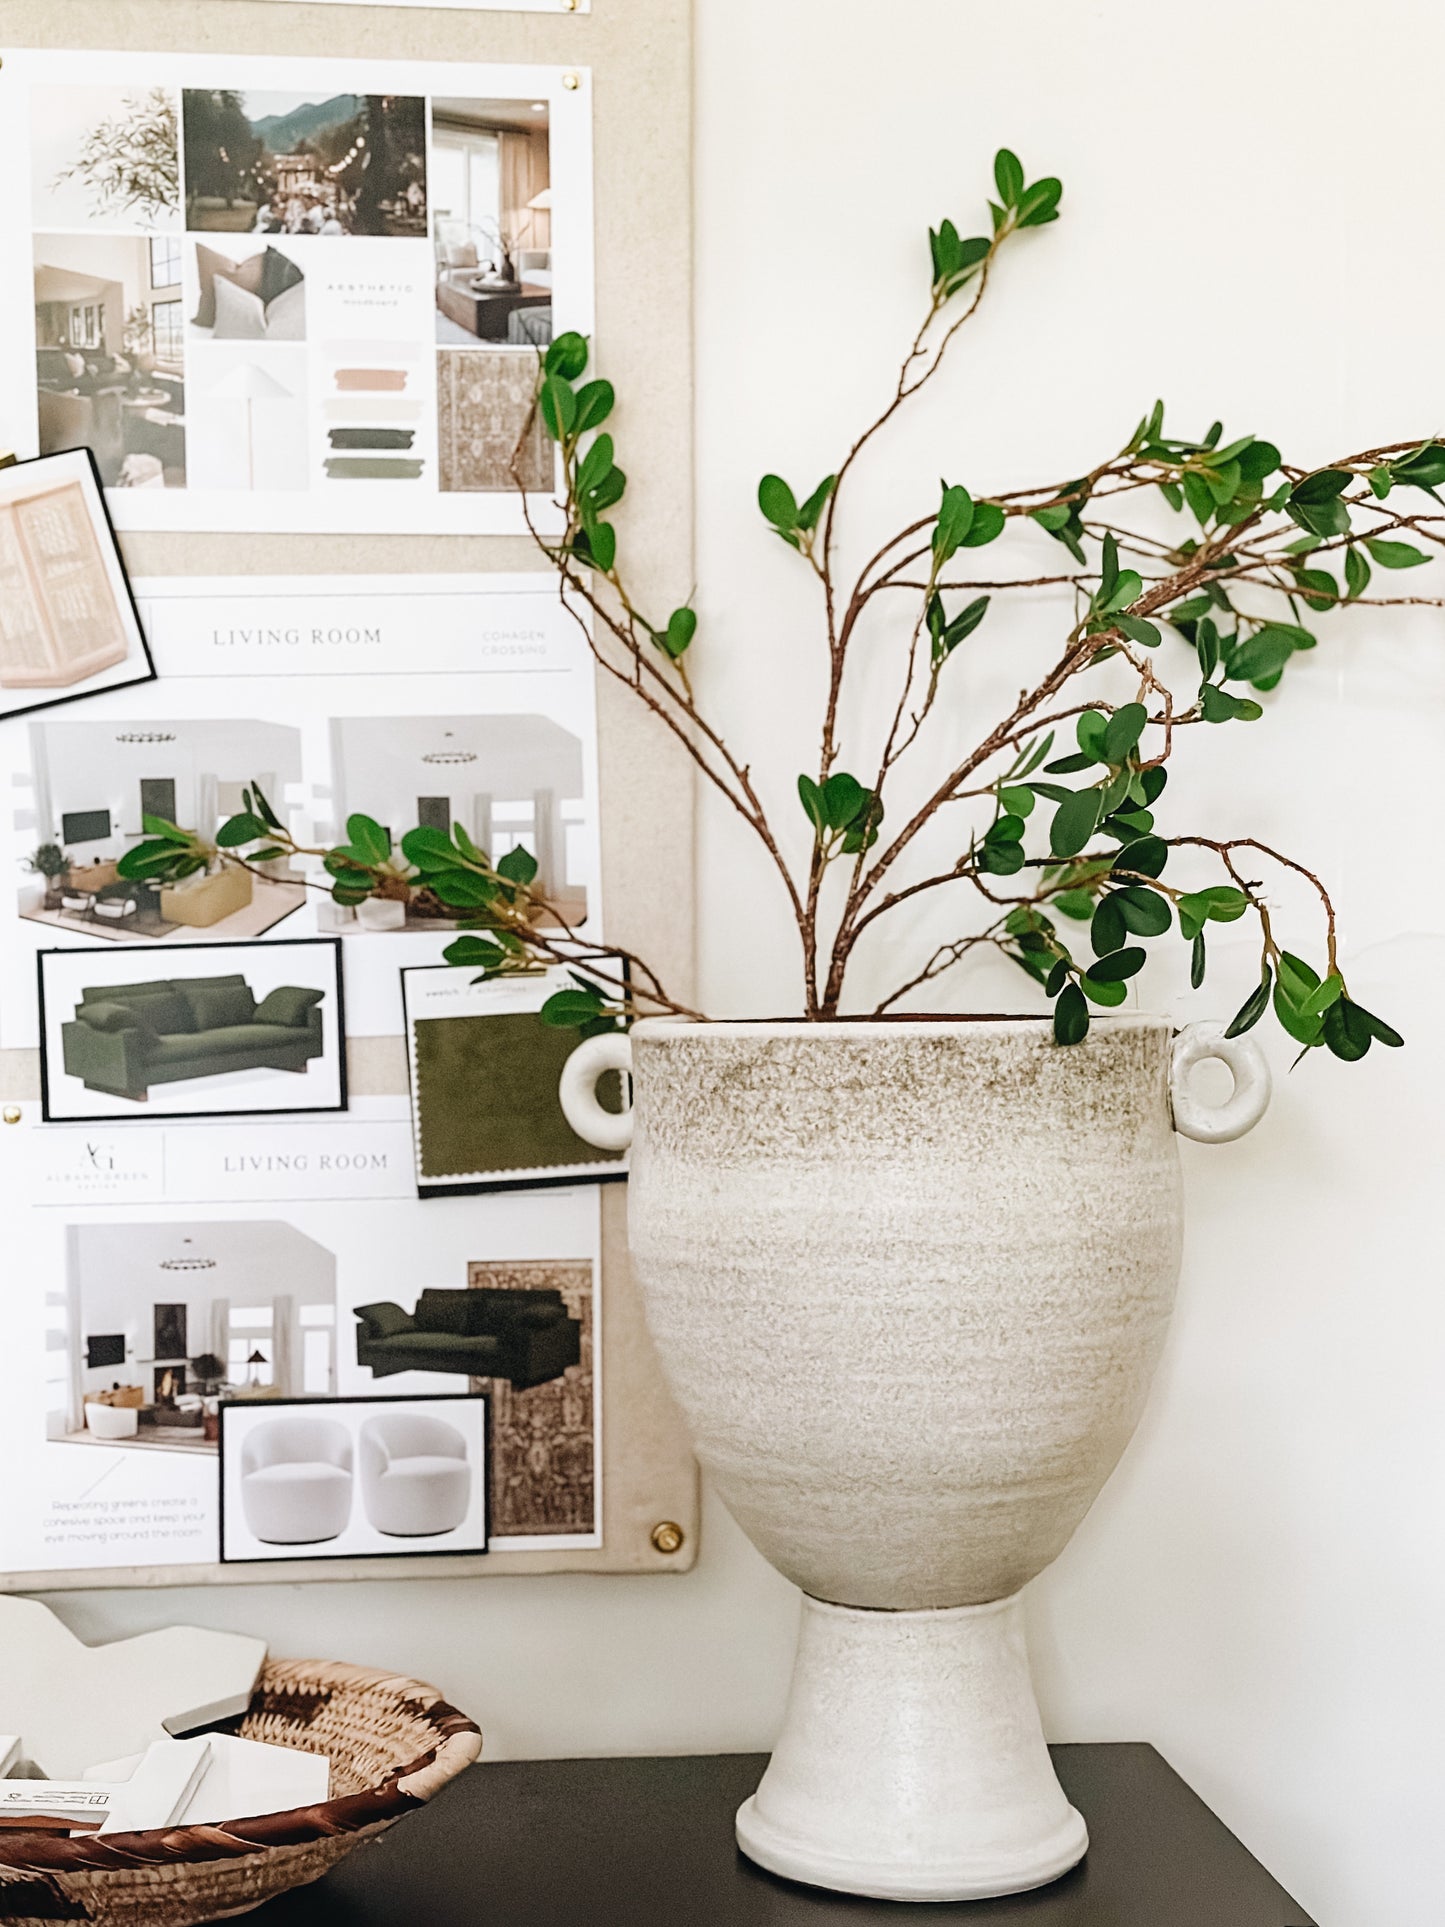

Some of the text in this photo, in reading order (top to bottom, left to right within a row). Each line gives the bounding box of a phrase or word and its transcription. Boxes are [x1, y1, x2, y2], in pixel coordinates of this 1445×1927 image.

[212, 627, 382, 645] LIVING ROOM
[481, 645, 547, 656] CROSSING
[224, 1153, 388, 1172] LIVING ROOM
[51, 1497, 199, 1512] Repeating greens create a
[43, 1512, 206, 1527] cohesive space and keep your
[44, 1534, 65, 1544] eye
[67, 1532, 107, 1544] moving
[109, 1530, 149, 1541] around
[152, 1529, 170, 1538] the
